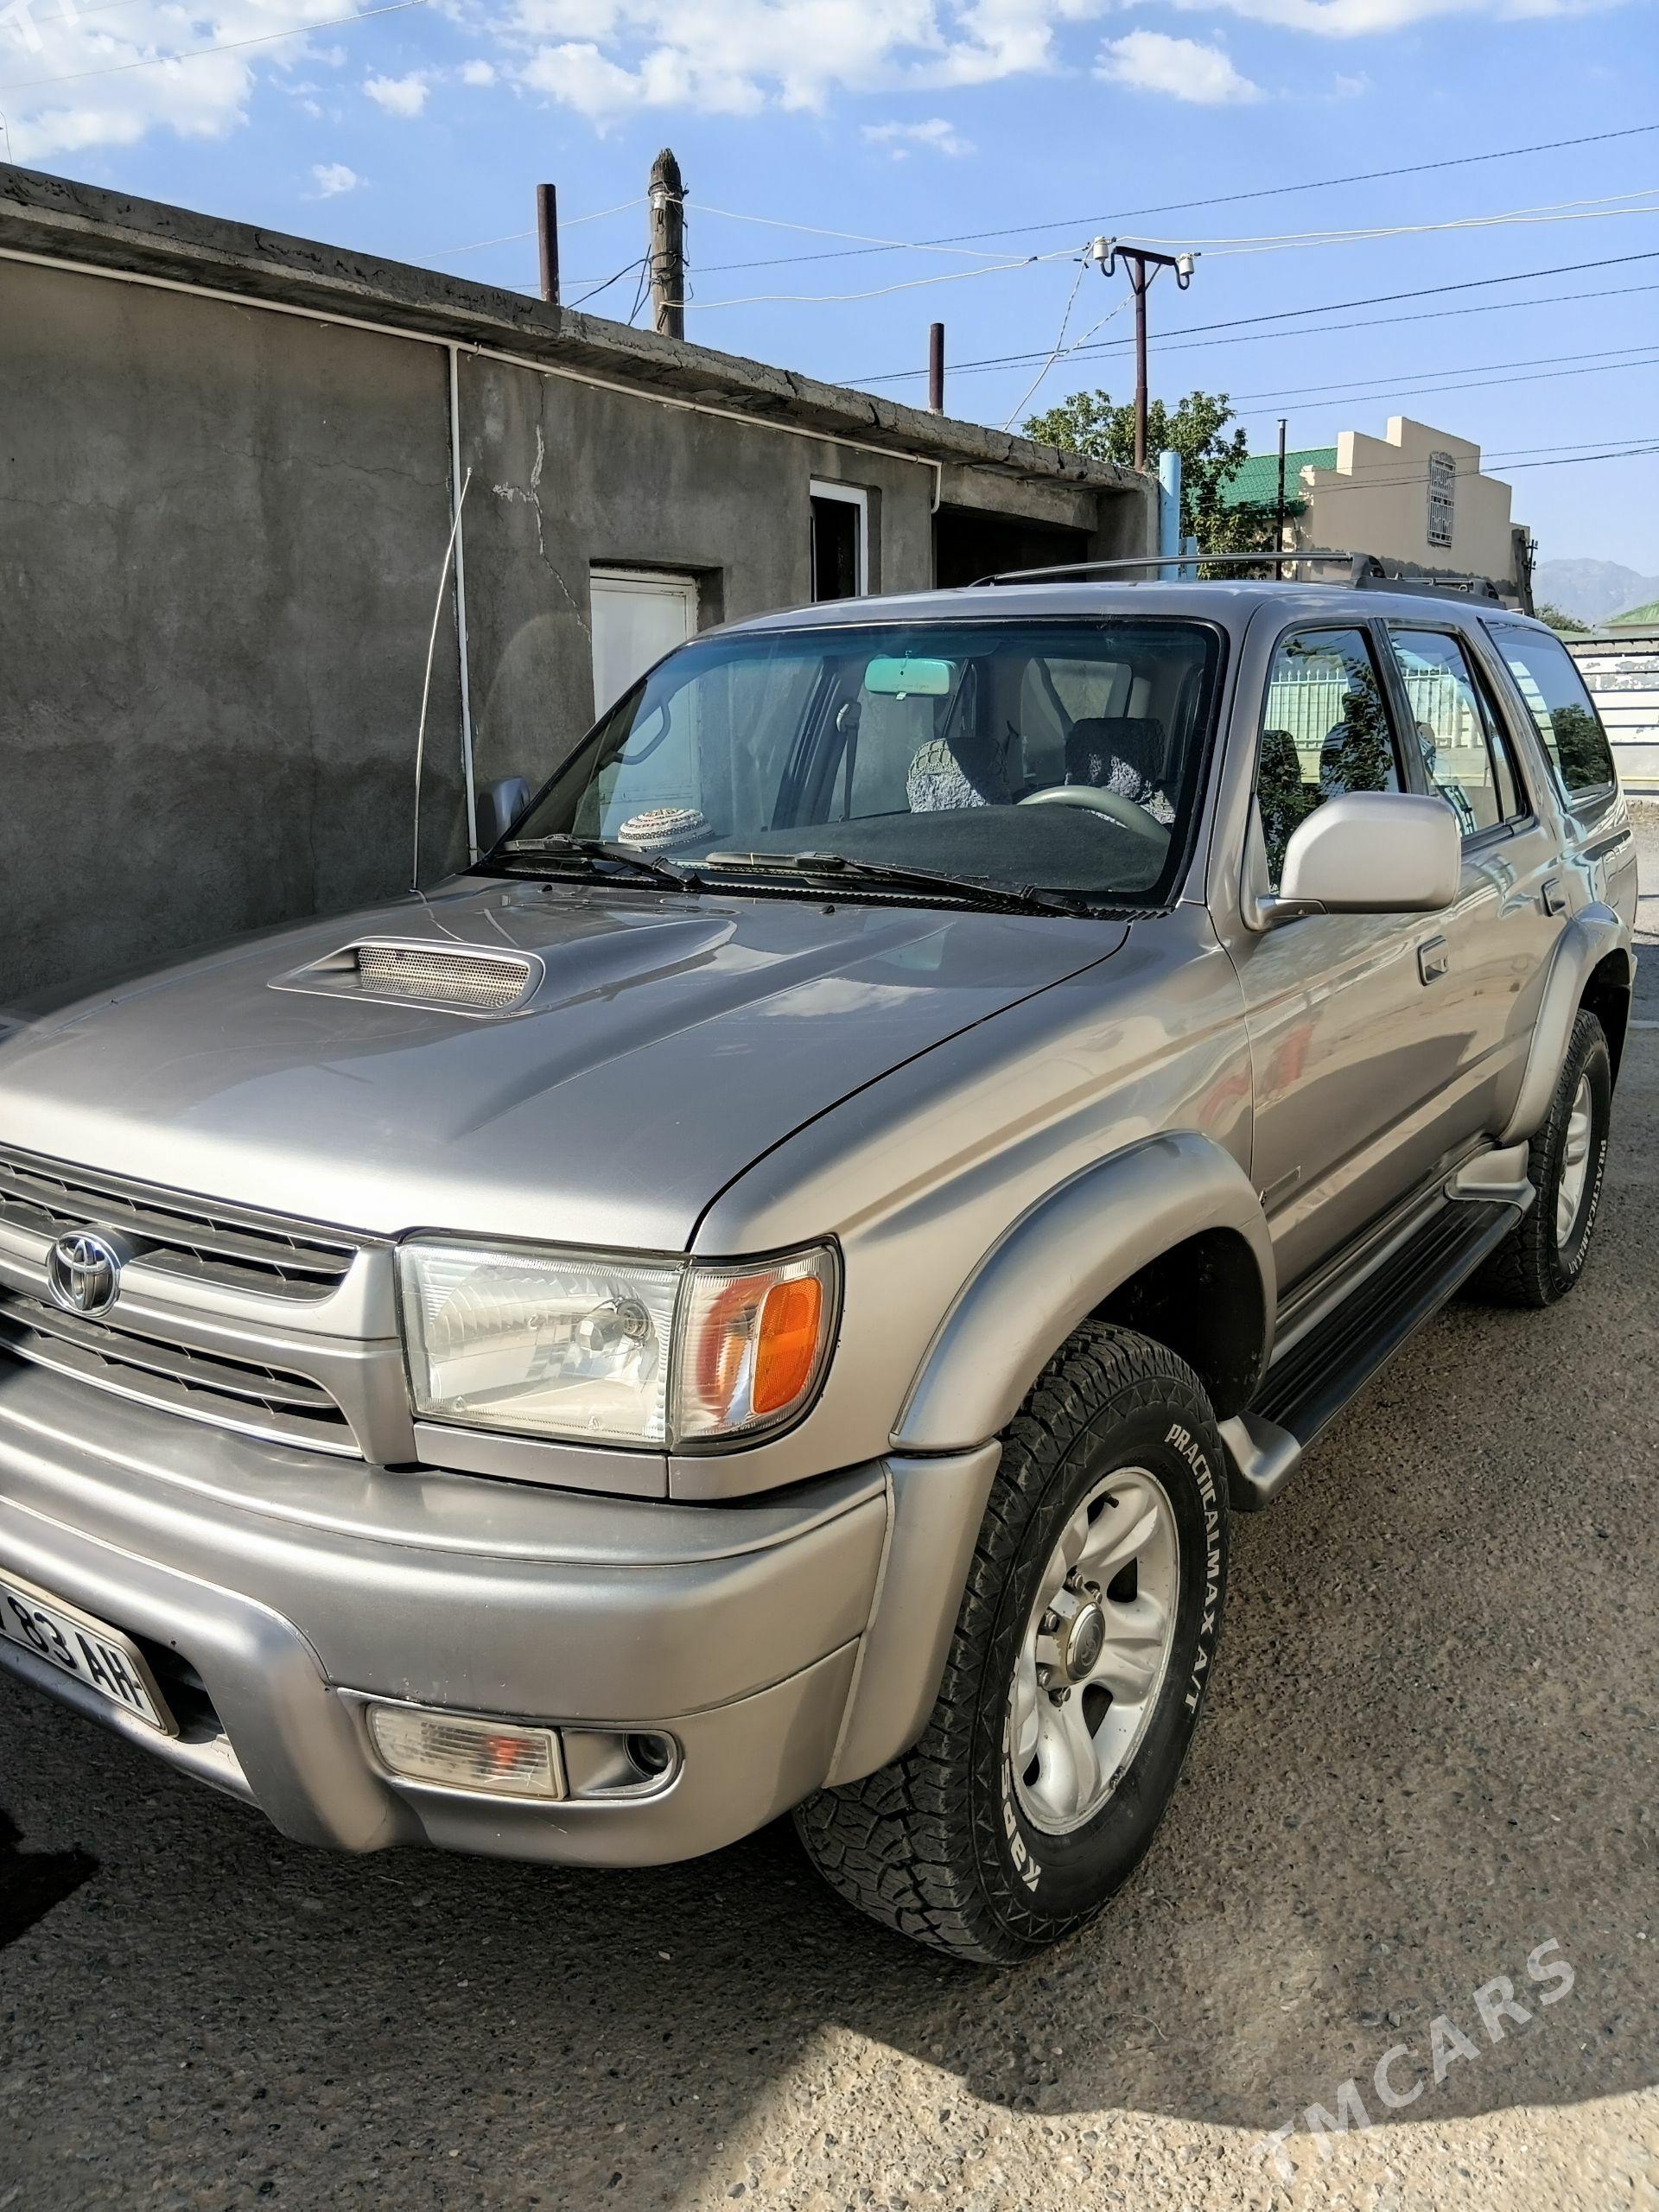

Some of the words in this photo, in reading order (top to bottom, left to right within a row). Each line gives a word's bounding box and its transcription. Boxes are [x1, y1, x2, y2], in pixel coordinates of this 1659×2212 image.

[1164, 1423, 1220, 1635] PRACTICALMAX
[0, 1596, 78, 1669] 83
[74, 1631, 145, 1710] AH
[1185, 1644, 1208, 1714] A/T
